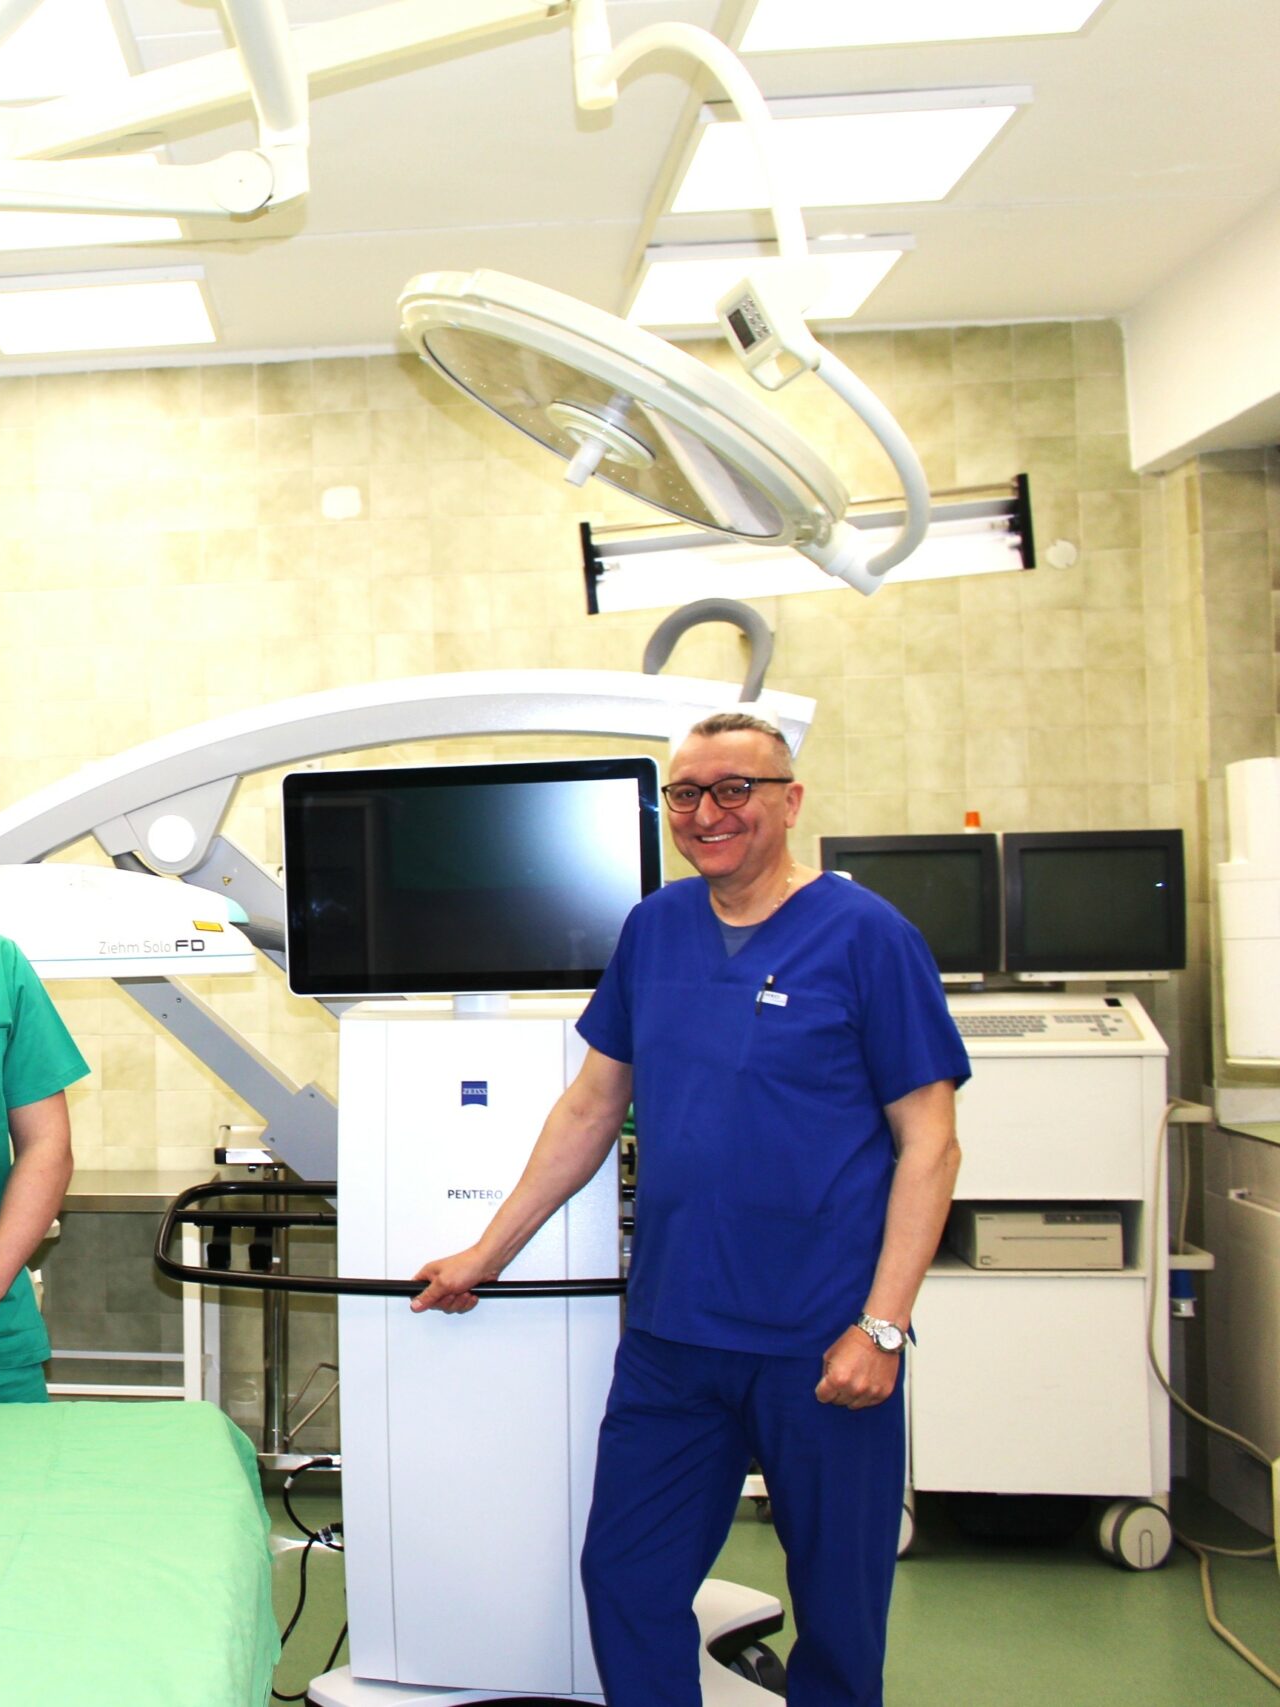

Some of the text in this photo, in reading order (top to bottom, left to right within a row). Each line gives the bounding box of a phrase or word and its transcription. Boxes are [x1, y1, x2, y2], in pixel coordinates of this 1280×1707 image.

[99, 939, 205, 954] Ziehm Solo FD
[447, 1189, 503, 1200] PENTERO
